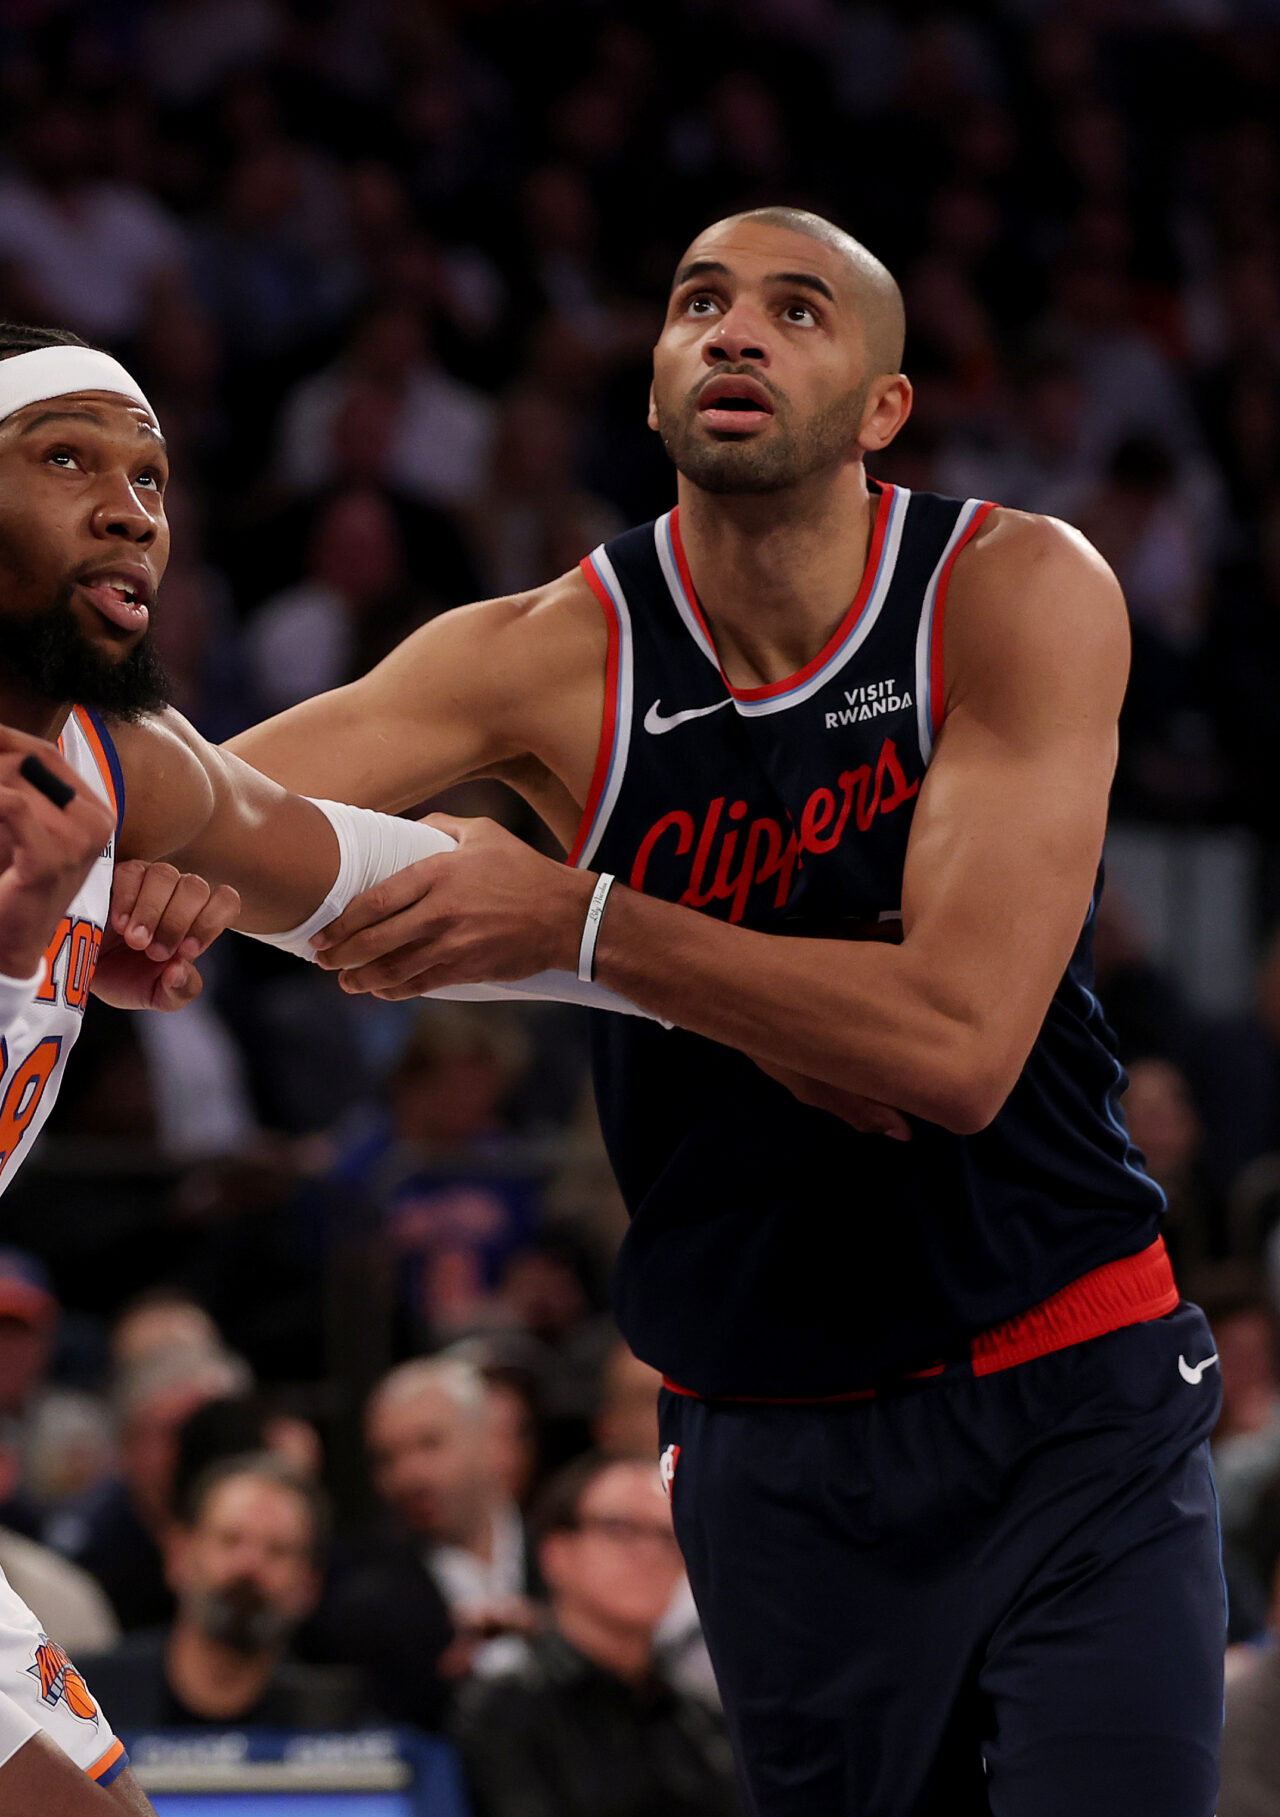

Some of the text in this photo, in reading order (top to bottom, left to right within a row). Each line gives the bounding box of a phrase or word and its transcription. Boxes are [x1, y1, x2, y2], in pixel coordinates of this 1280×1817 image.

[825, 692, 913, 729] RWANDA
[844, 679, 896, 706] VISIT
[630, 738, 919, 923] Clippers
